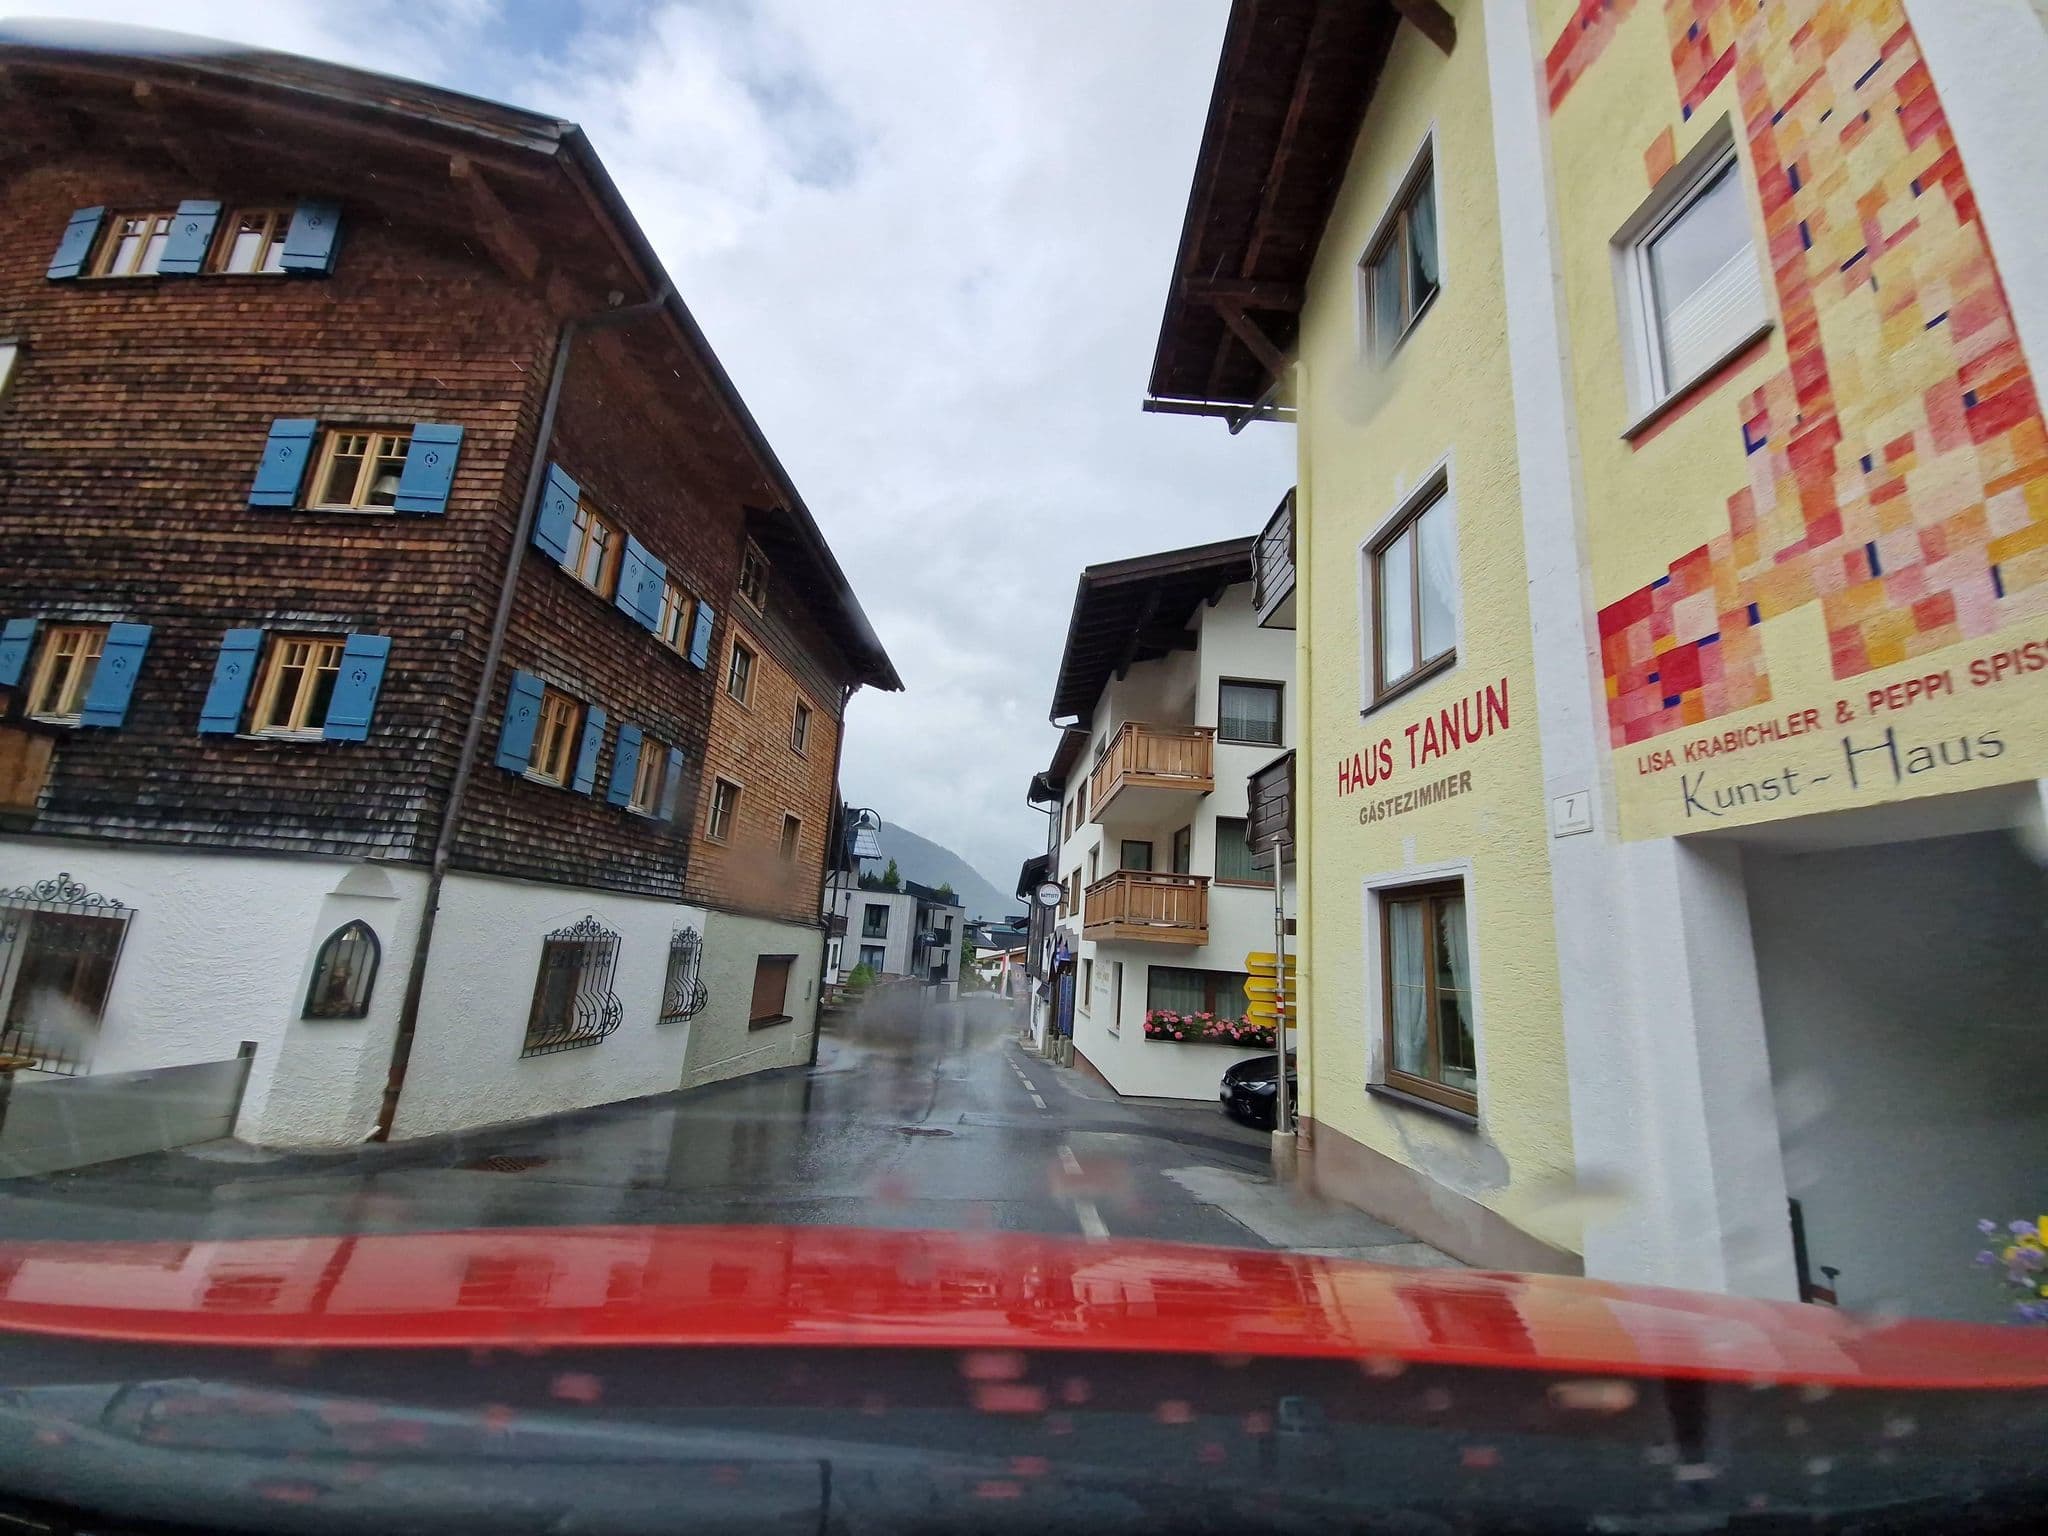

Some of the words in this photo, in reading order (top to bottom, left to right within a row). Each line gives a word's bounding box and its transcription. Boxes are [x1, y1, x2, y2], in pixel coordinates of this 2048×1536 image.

[1338, 738, 1392, 797] HAUS
[1405, 677, 1510, 769] TANUN
[1637, 751, 1676, 776] LISA
[1684, 708, 1820, 764] KRABICHLER
[1835, 700, 1854, 725] &
[1869, 670, 1953, 716] PEPPI
[1969, 638, 2048, 687] SPIS
[1359, 770, 1473, 825] GÄSTEZIMMER
[1566, 798, 1575, 818] 7
